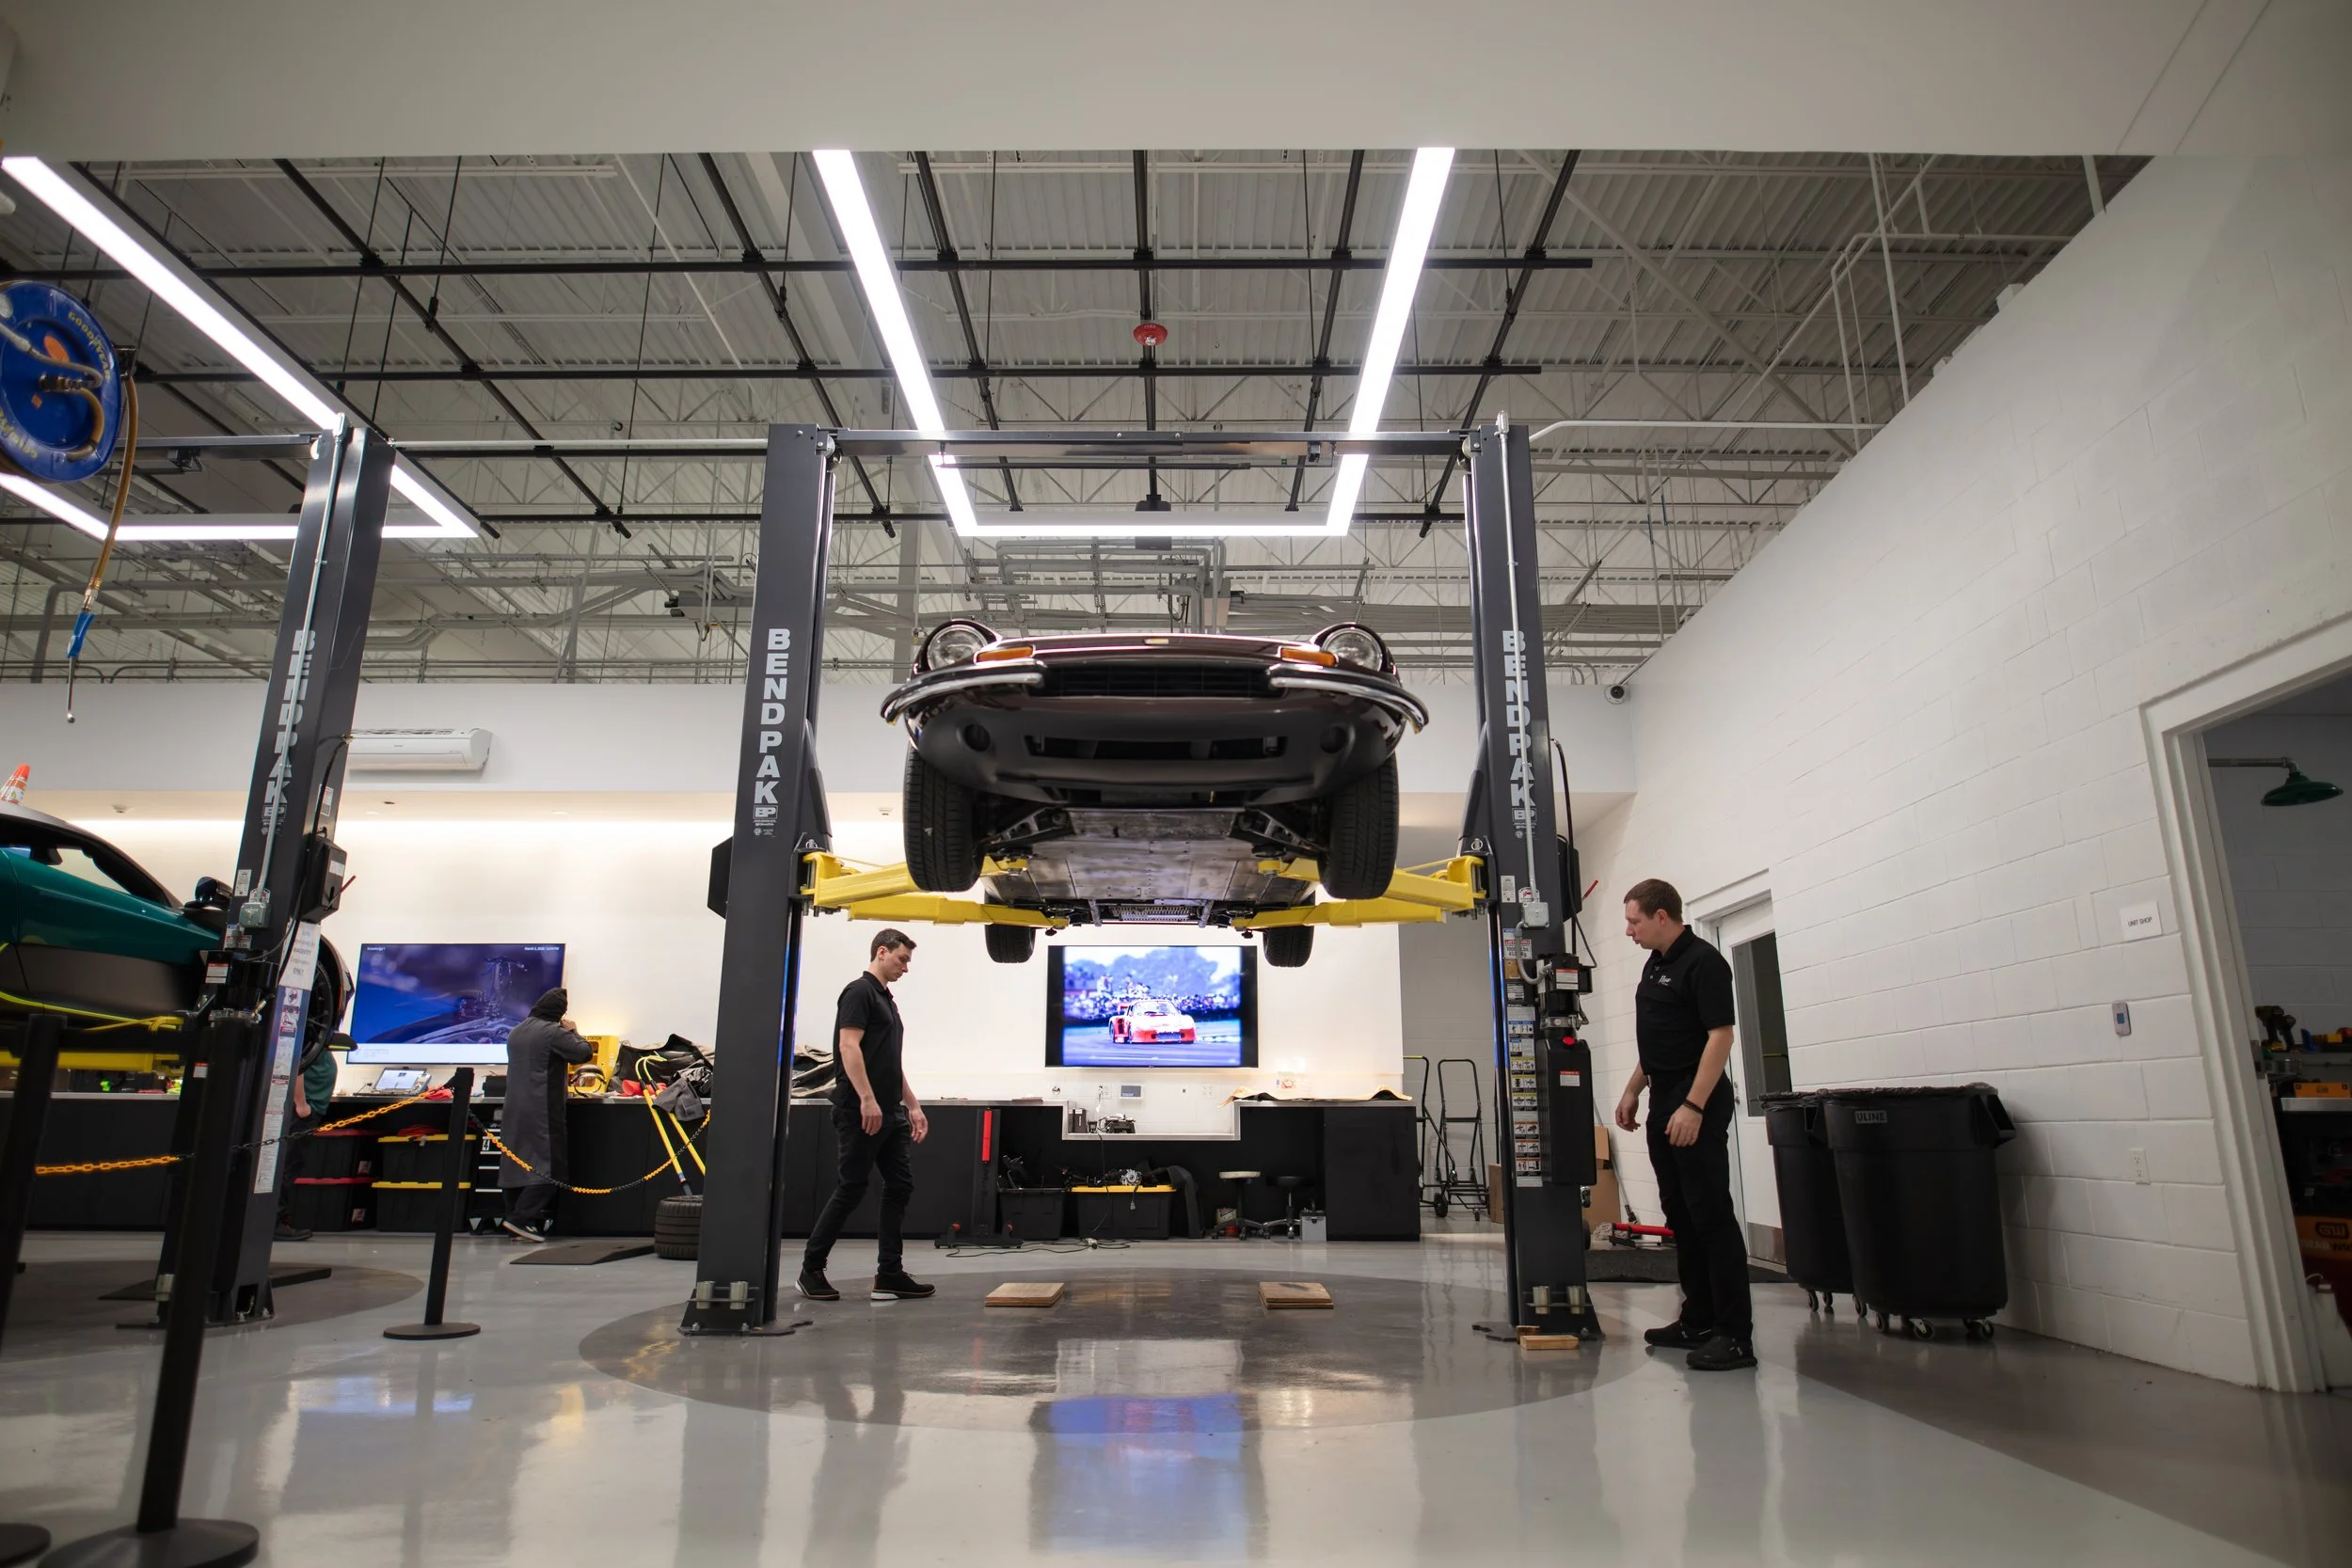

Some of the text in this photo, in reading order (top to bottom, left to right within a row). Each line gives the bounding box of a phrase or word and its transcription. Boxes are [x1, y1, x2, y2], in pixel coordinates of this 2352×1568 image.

[753, 627, 791, 805] BENDPAK
[755, 806, 777, 818] BP
[2139, 916, 2153, 925] SHOP
[1856, 1111, 1886, 1122] ULINE
